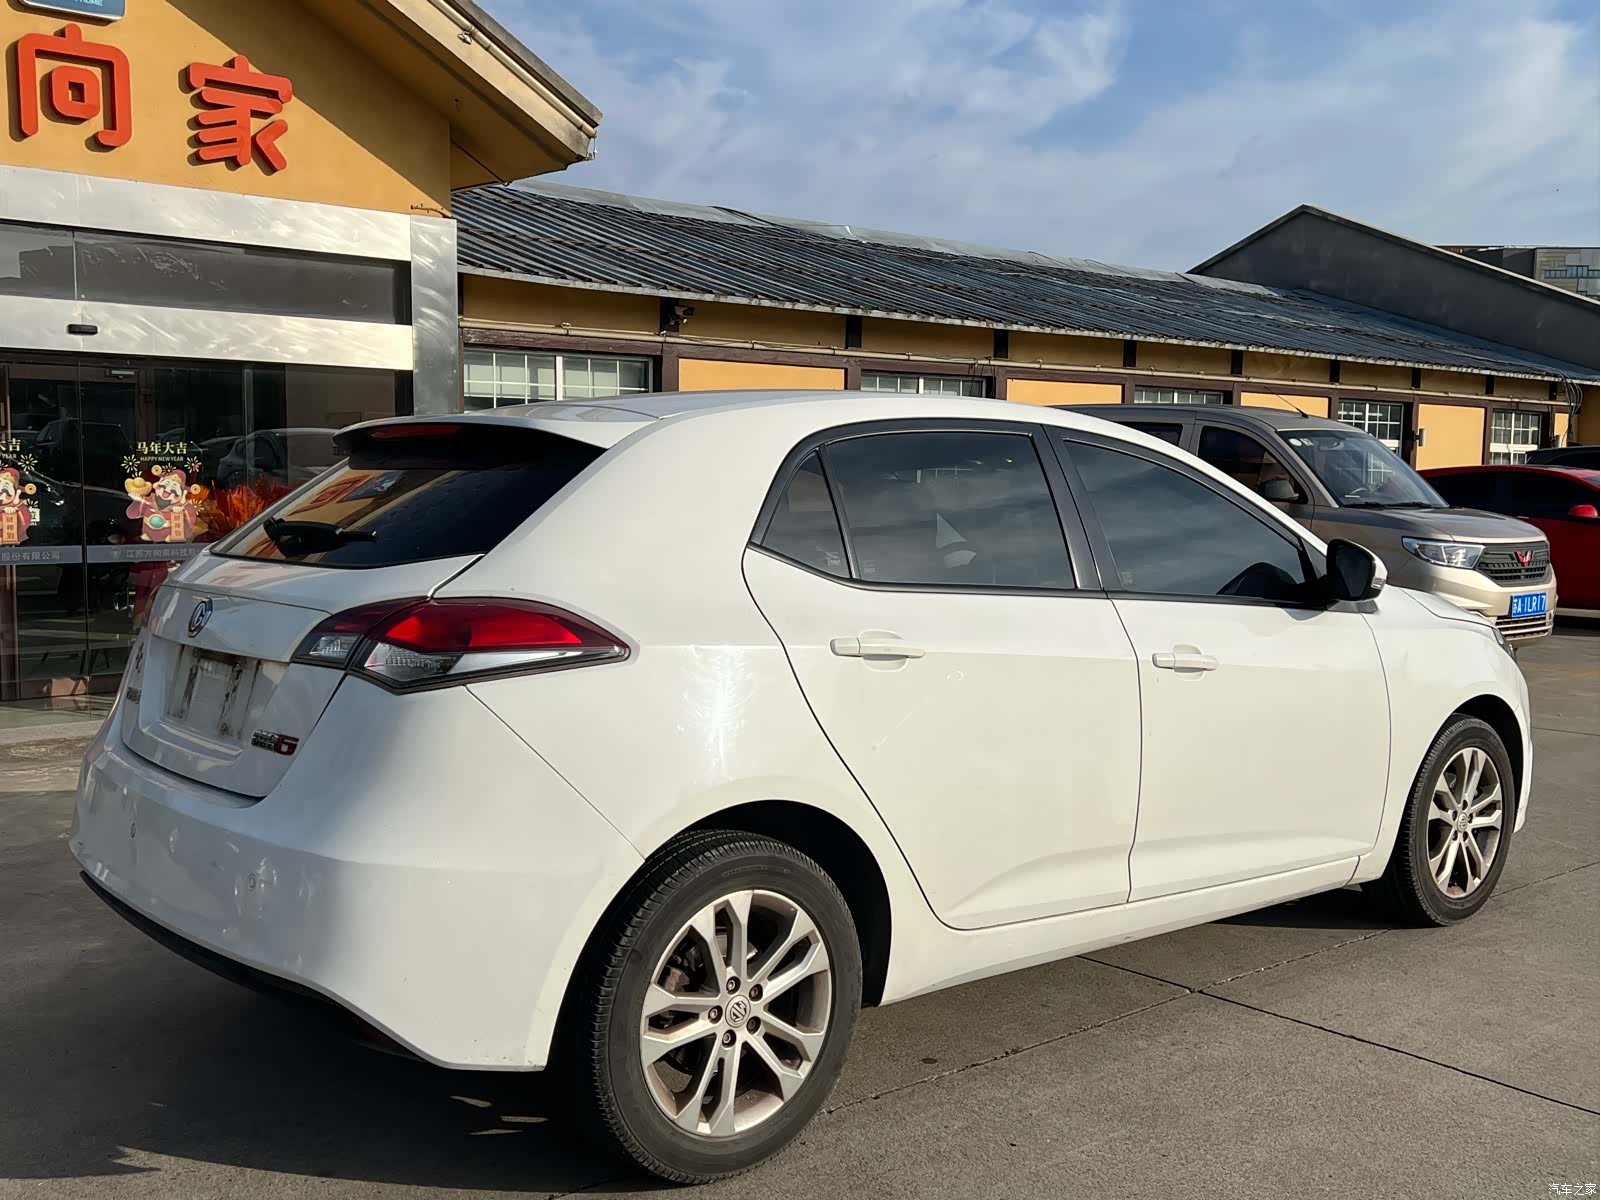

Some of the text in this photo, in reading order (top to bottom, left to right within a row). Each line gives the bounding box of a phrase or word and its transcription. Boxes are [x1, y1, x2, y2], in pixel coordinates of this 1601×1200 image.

[17, 23, 293, 171] 向家
[136, 441, 188, 455] 马年大吉
